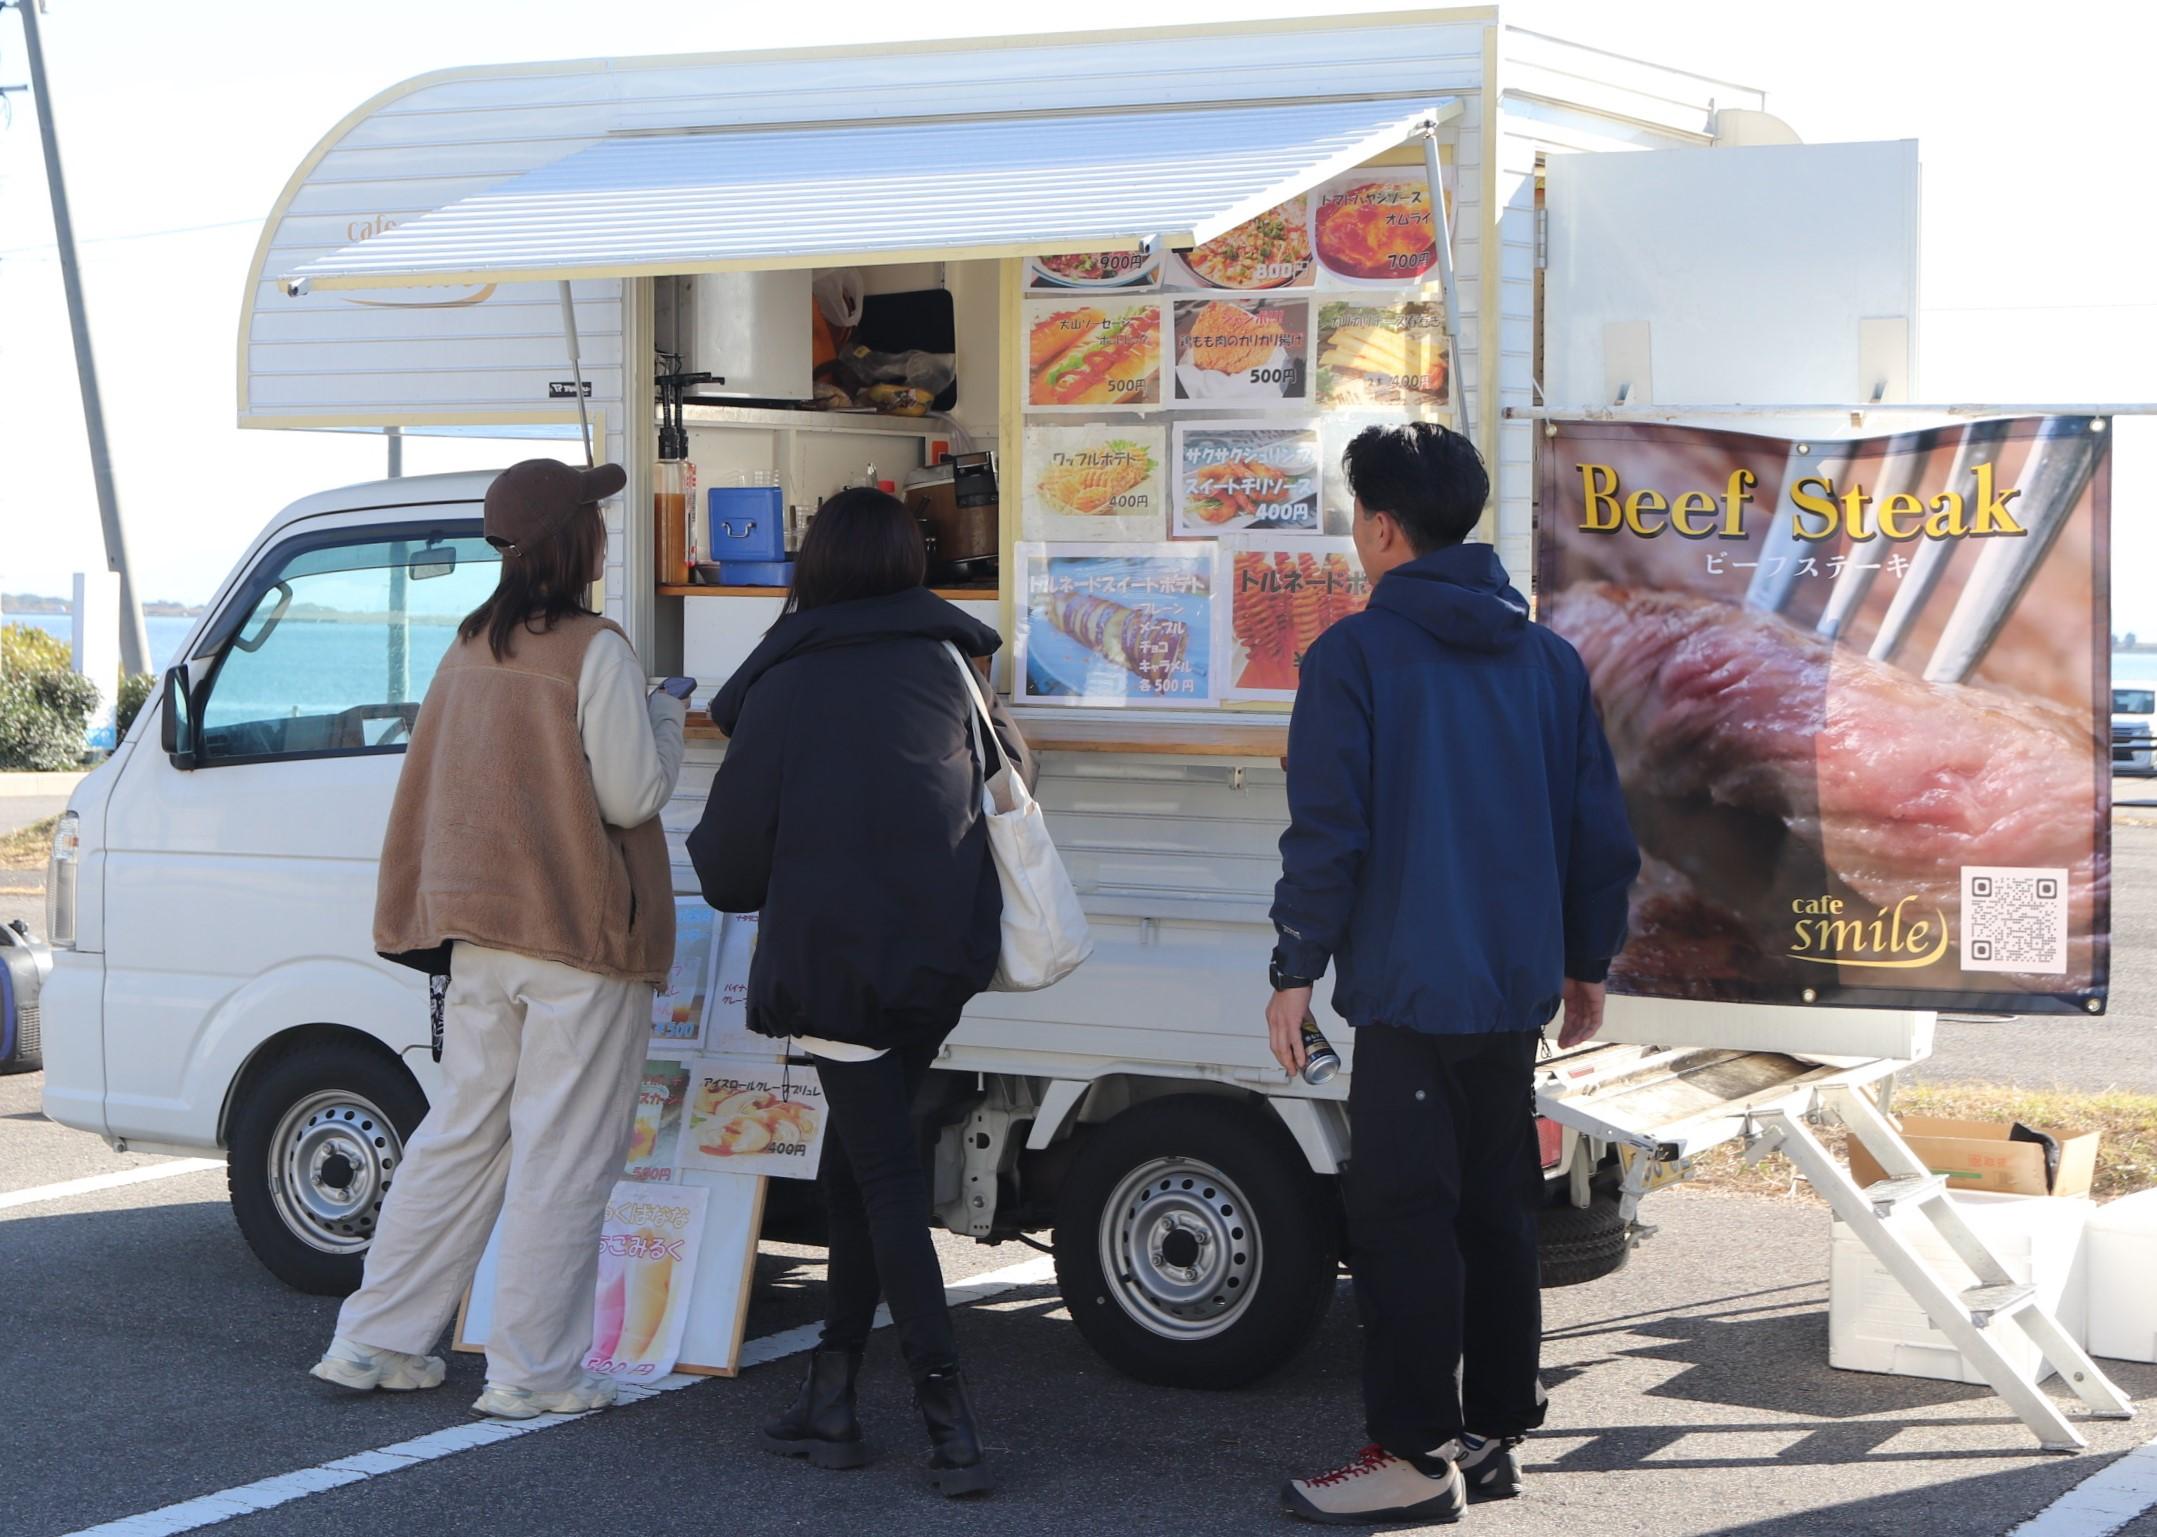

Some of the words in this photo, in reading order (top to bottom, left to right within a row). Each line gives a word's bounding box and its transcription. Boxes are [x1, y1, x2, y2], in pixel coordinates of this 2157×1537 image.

[346, 214, 398, 241] cafe
[1100, 254, 1143, 270] 900円
[1387, 252, 1431, 270] 700円
[1249, 368, 1297, 385] 500円
[1107, 378, 1146, 393] 500円
[1184, 477, 1313, 496] スイートチリソース
[1109, 494, 1149, 508] 400円
[1574, 460, 1758, 541] Beef
[1788, 460, 2028, 543] Steak
[1255, 502, 1309, 521] 400円
[1704, 551, 1912, 580] ビーフステーキ
[1139, 621, 1186, 635] メープル
[1138, 641, 1169, 655] チョコ
[1138, 659, 1193, 674] キャラメル
[1791, 894, 1844, 916] cafe
[1792, 893, 1932, 955] smile
[768, 1141, 807, 1157] 400円
